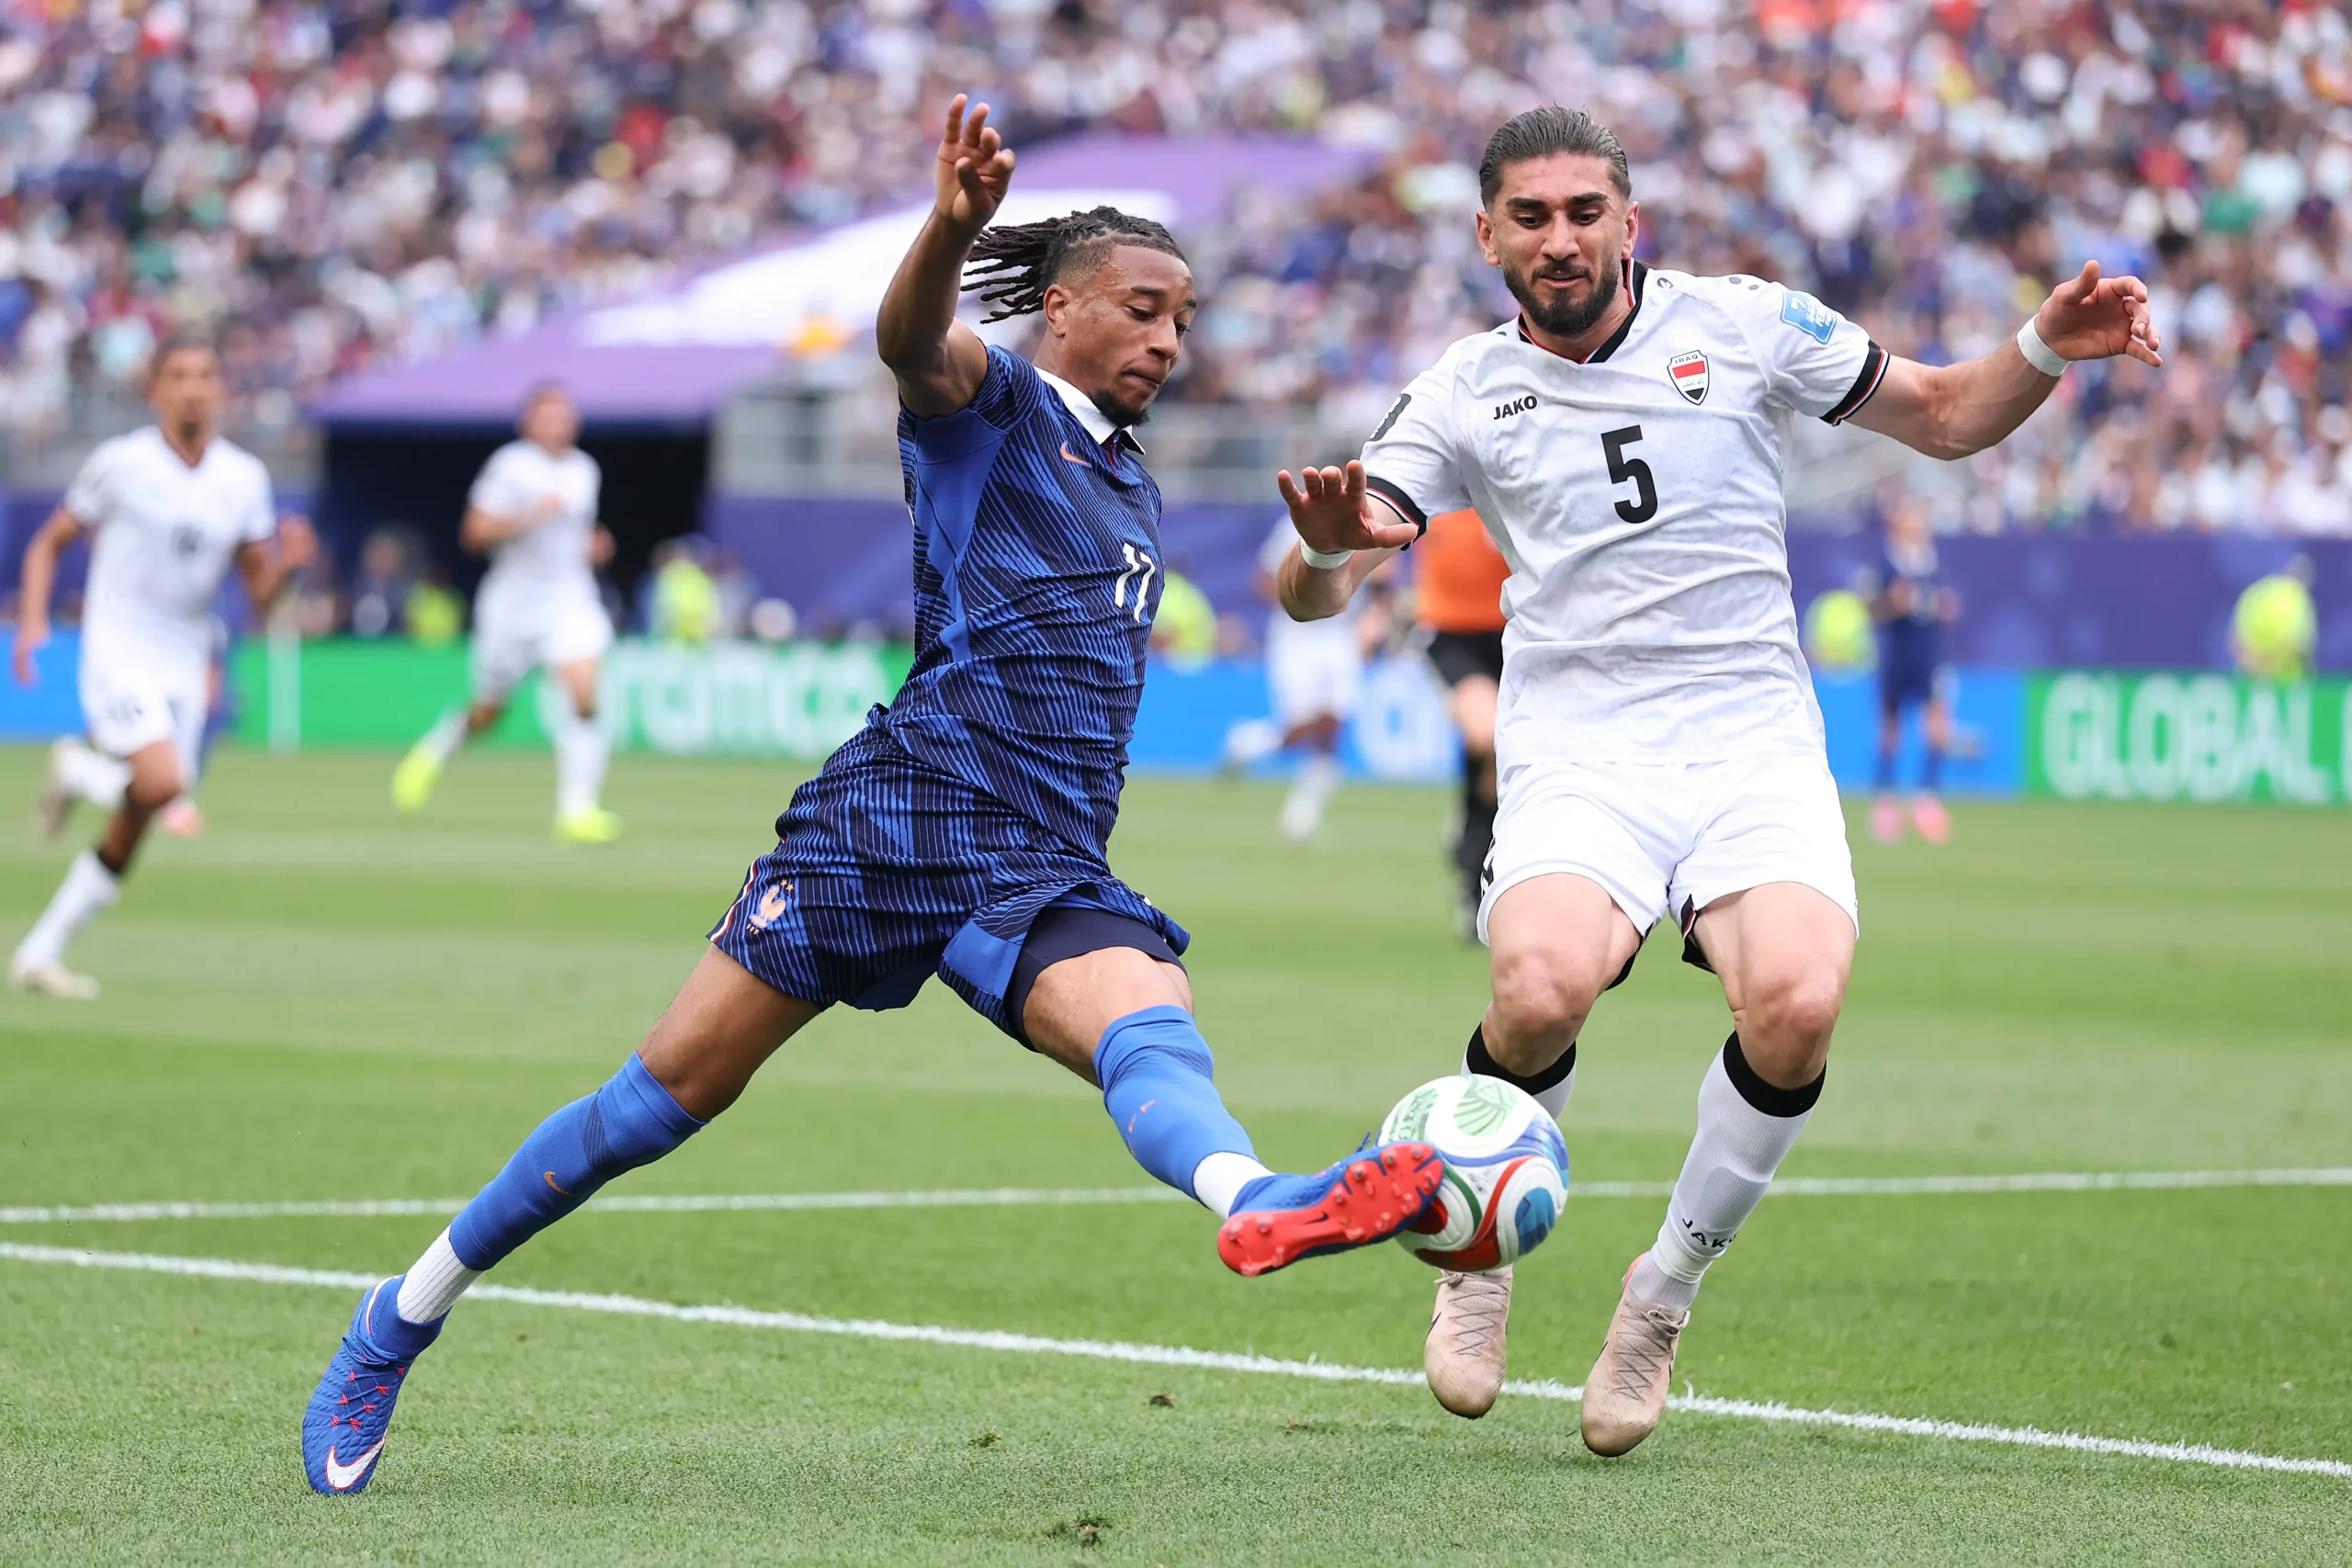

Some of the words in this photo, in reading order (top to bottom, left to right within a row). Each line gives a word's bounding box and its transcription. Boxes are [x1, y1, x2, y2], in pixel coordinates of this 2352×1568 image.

[1675, 354, 1699, 365] IRAQ
[1493, 395, 1538, 420] JAKO
[1600, 424, 1658, 524] 5
[2041, 673, 2331, 802] GLOBAL
